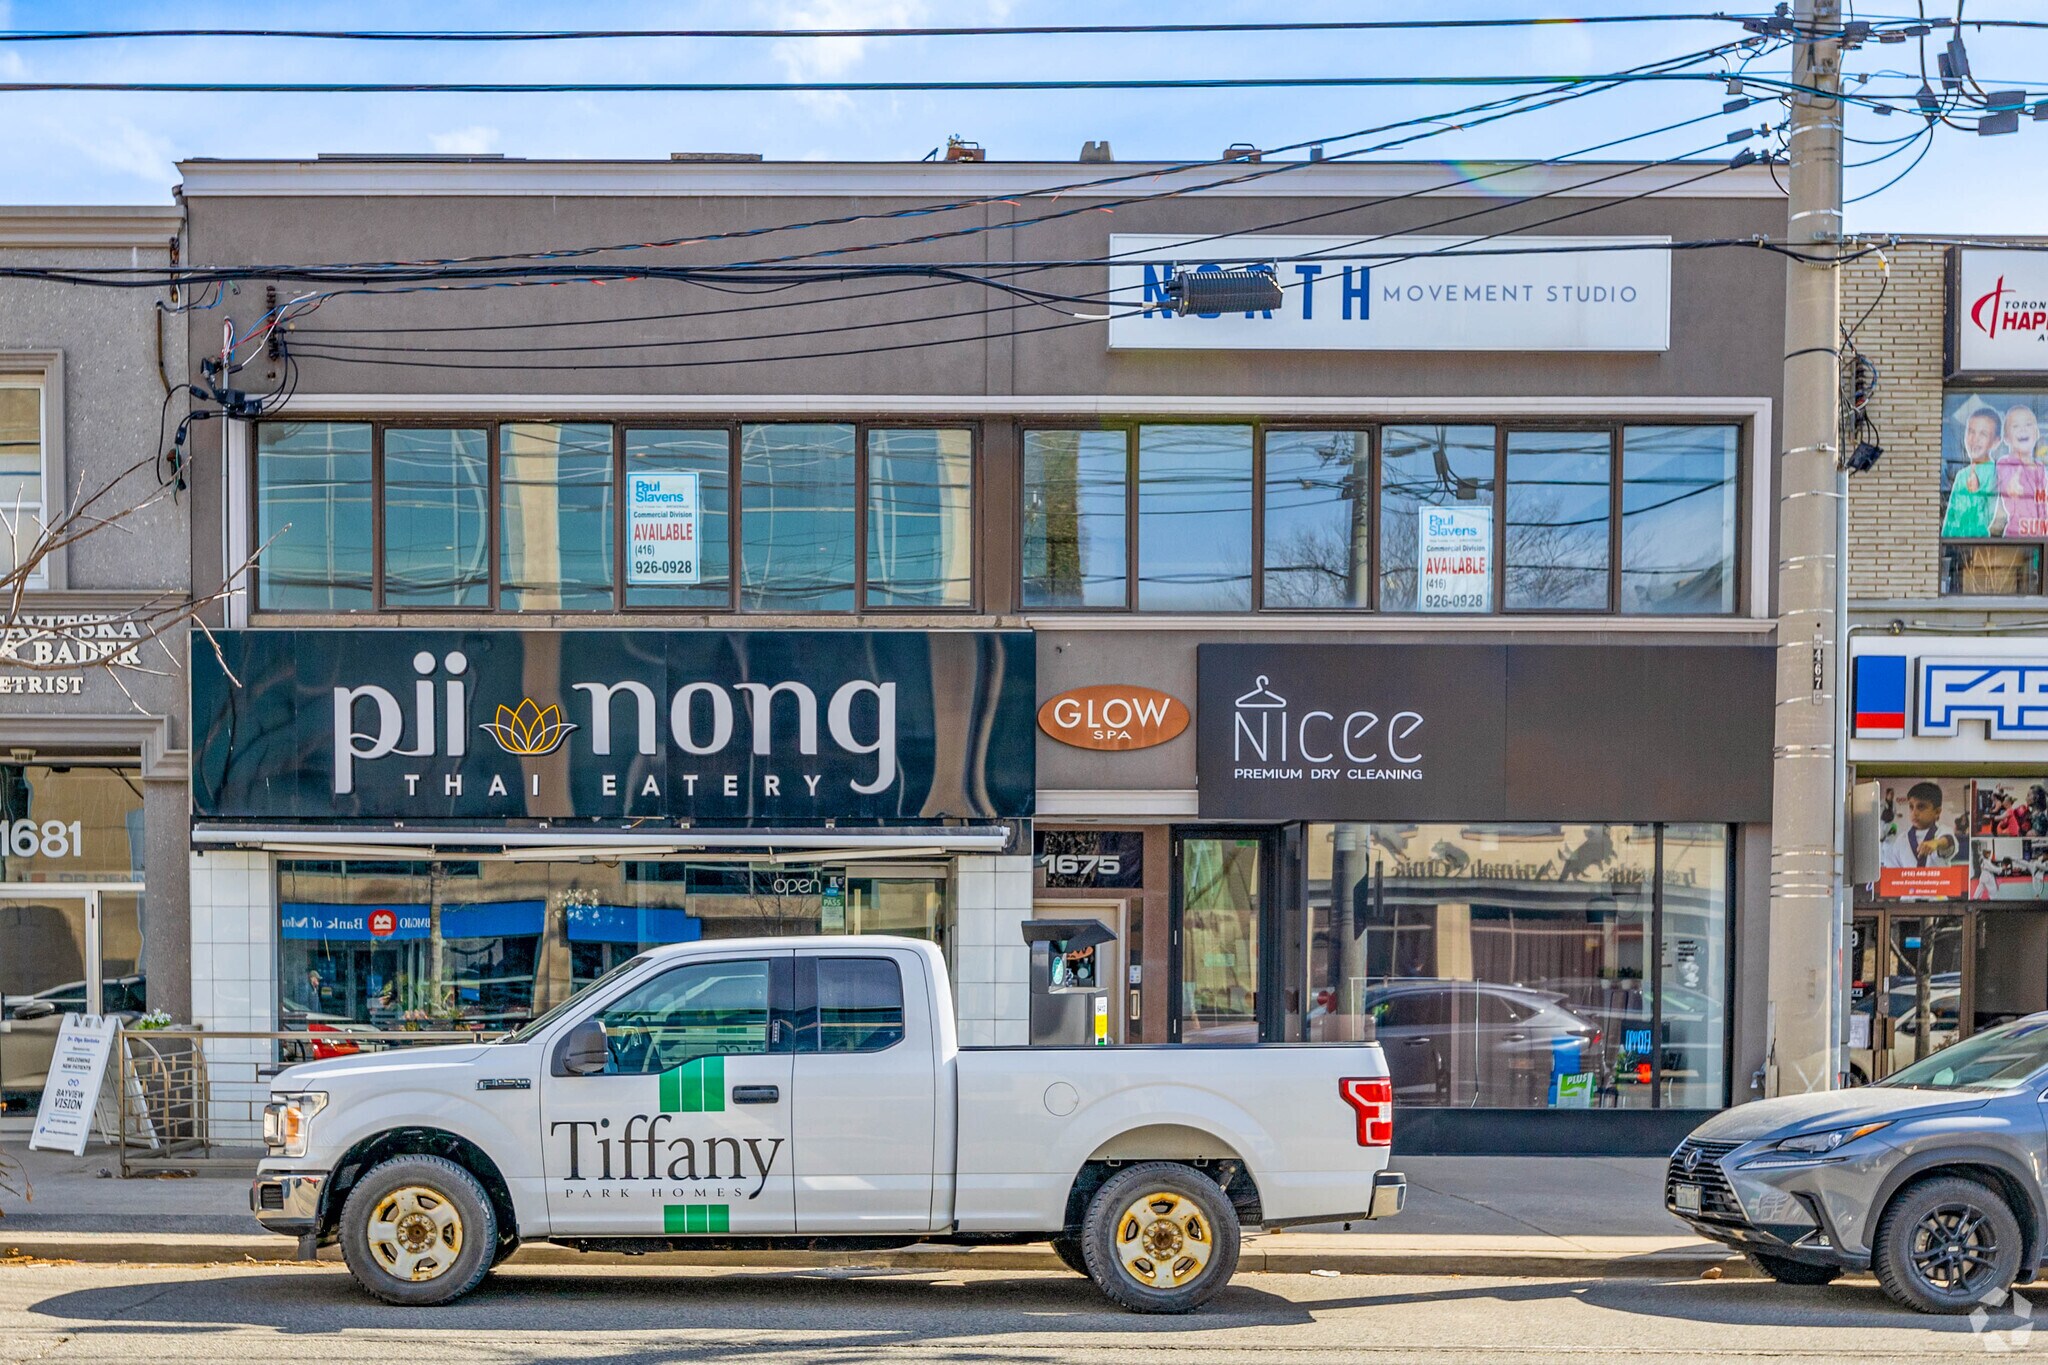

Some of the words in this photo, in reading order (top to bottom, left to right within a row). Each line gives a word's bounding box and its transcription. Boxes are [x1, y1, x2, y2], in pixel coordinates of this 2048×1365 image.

[1144, 264, 1370, 320] NTH
[1383, 285, 1534, 303] MOVEMENT
[1546, 285, 1638, 303] STUDIO
[2002, 312, 2048, 330] HAP
[636, 481, 660, 492] Paul
[635, 492, 684, 502] Slavens
[1429, 515, 1454, 526] Paul
[634, 523, 692, 541] AVAILABLE
[1429, 525, 1477, 536] Slavens
[635, 545, 655, 557] (416)
[636, 561, 692, 573] 926-0928
[1426, 557, 1485, 575] AVAILABLE
[1426, 579, 1447, 591] (416)
[1426, 594, 1483, 607] 926-0928
[33, 641, 141, 665] BADER
[1054, 698, 1171, 729] GLOW
[333, 650, 466, 795] pii
[572, 680, 897, 795] nong
[1093, 730, 1131, 740] SPA
[1234, 769, 1302, 780] PREMIUM
[1311, 769, 1341, 780] DRY
[1347, 769, 1423, 780] CLEANING
[405, 773, 541, 797] THAI
[602, 773, 823, 797] EATERY
[0, 820, 82, 858] 1681
[1040, 854, 1120, 875] 1675
[773, 878, 821, 896] open
[1567, 1073, 1588, 1085] PLUS
[56, 1088, 85, 1099] BAYVIEW
[54, 1097, 83, 1110] VISION
[551, 1114, 785, 1200] Tiffany
[566, 1188, 629, 1198] PARK
[652, 1187, 742, 1198] HOMES
